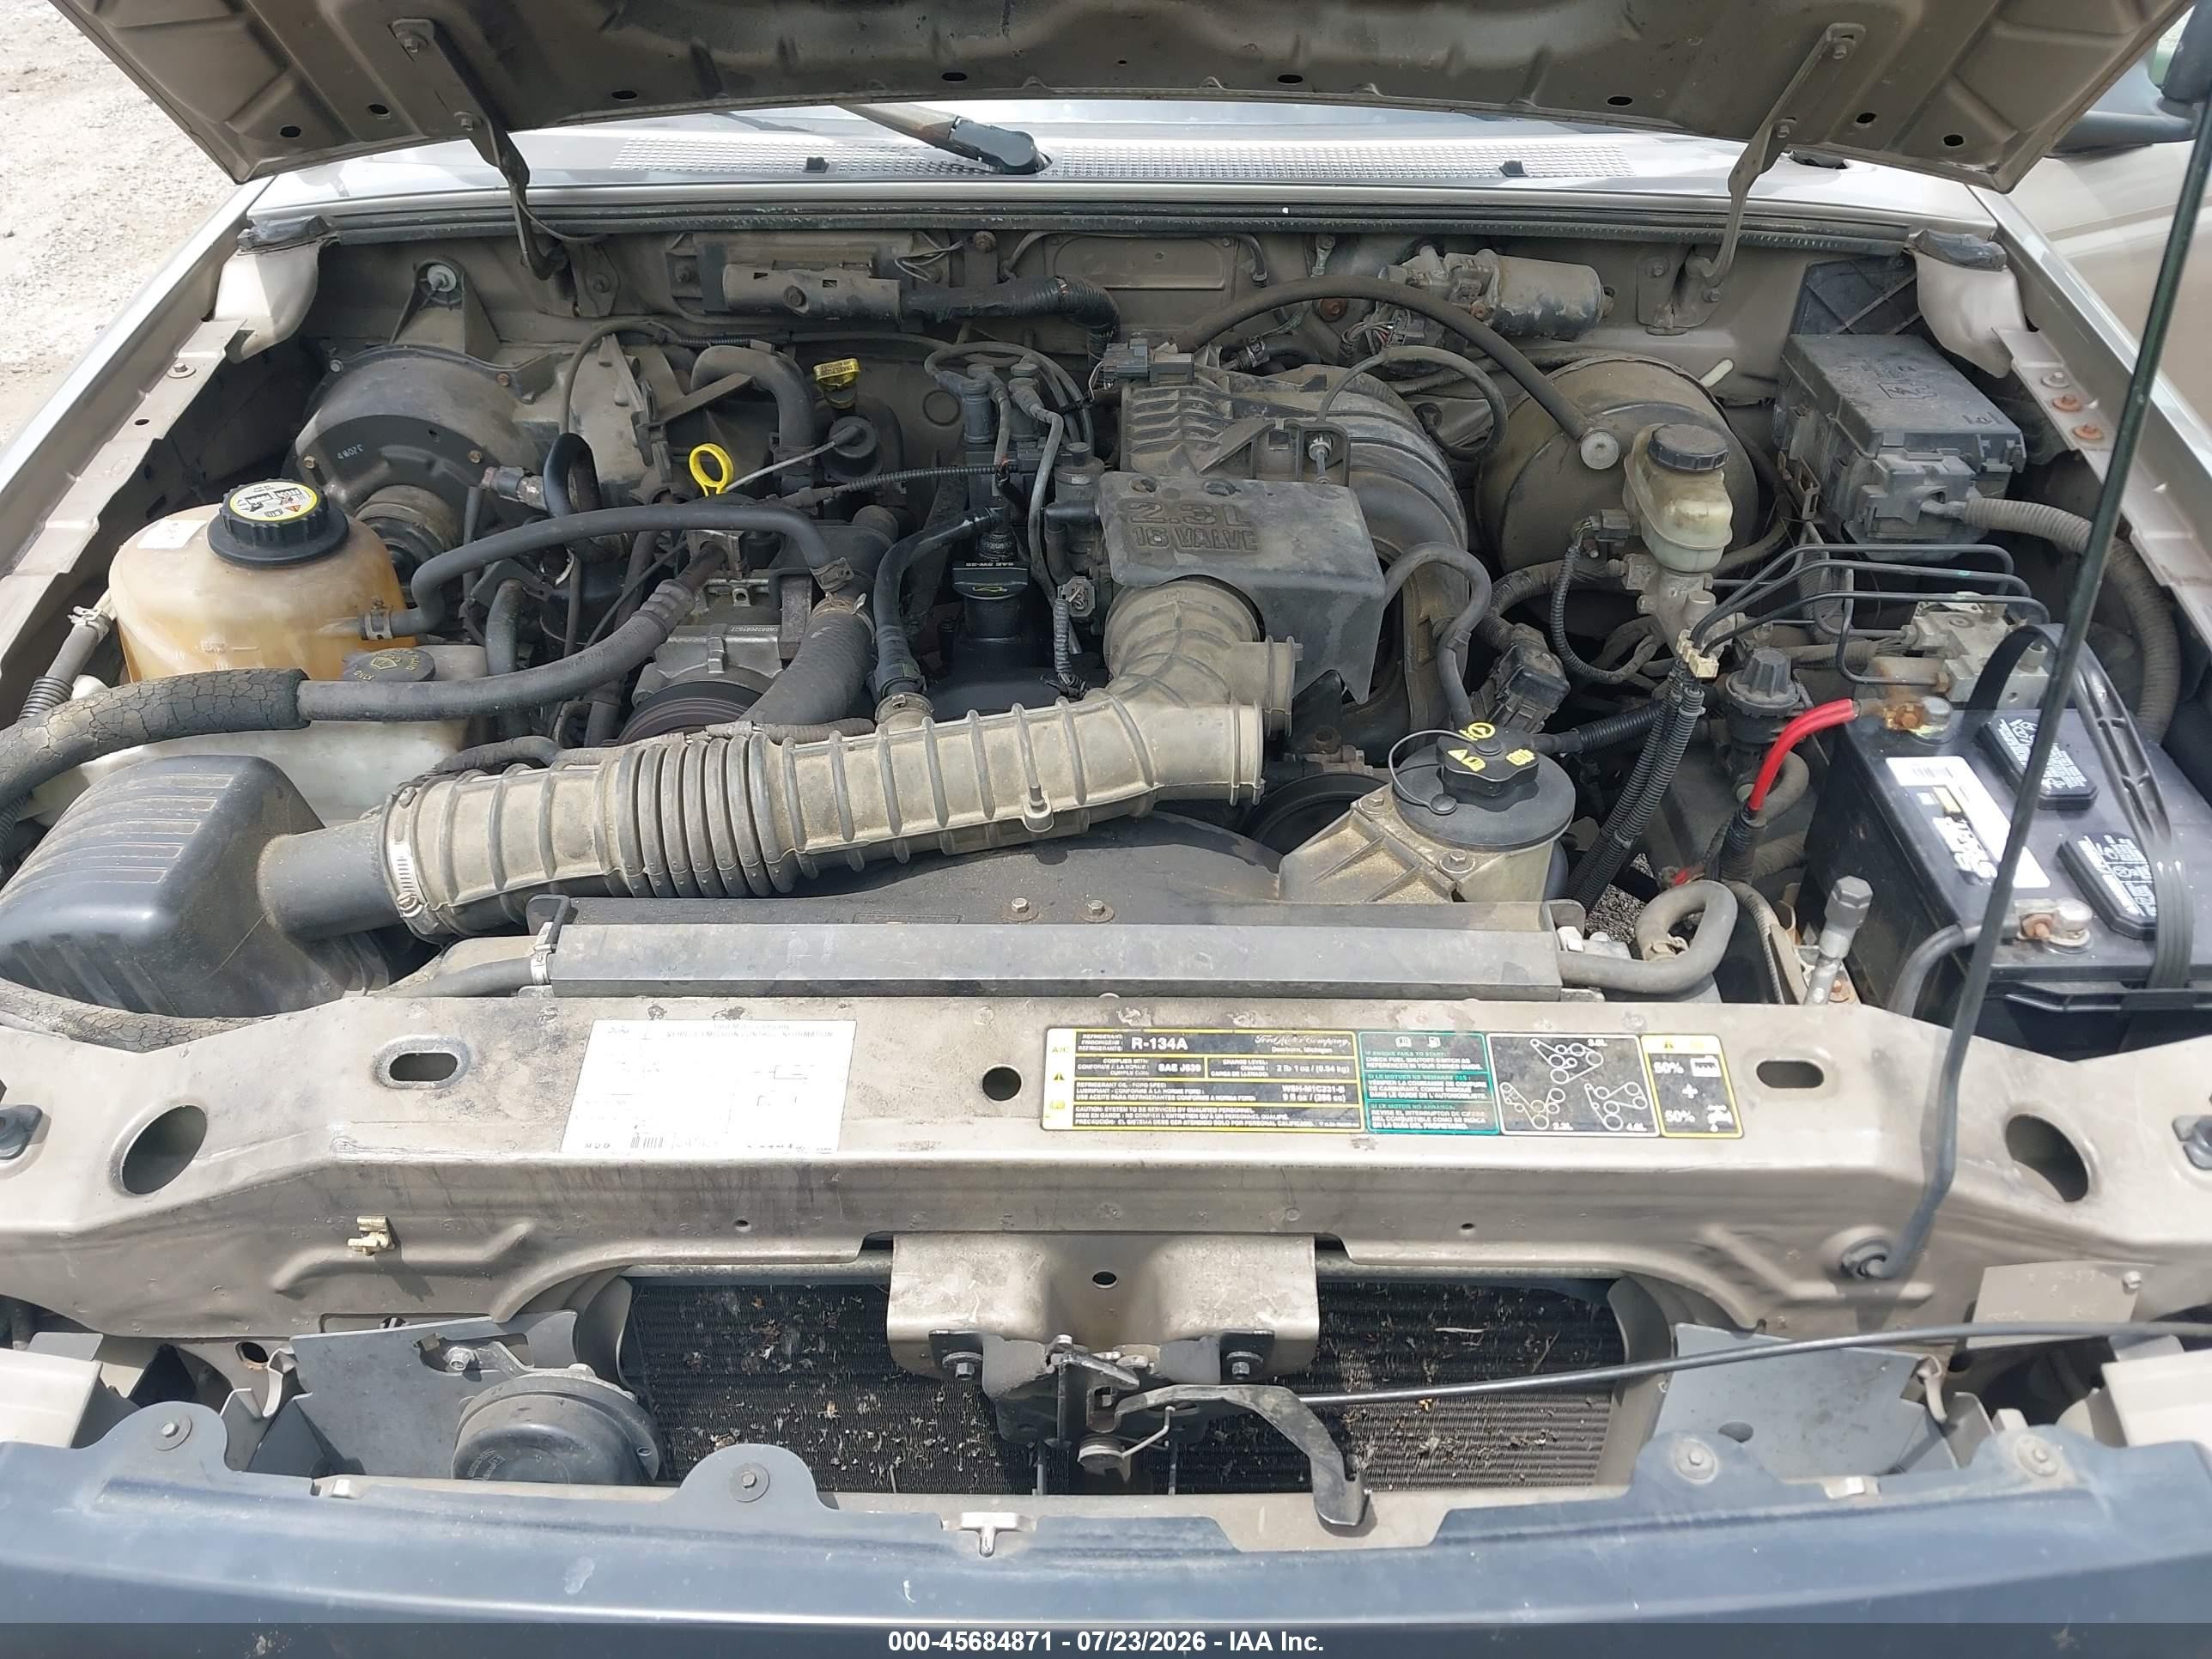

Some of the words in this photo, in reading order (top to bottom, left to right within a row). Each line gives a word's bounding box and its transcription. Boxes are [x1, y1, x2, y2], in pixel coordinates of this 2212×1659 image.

[1174, 527, 1258, 550] VALVE
[1131, 1036, 1188, 1050] R-134A
[1255, 1034, 1278, 1047] Ford
[1158, 1063, 1178, 1072] SAE
[1276, 1064, 1282, 1073] 2
[1284, 1064, 1292, 1073] lb
[1300, 1064, 1310, 1073] oz
[1653, 1061, 1685, 1074] 50%
[1665, 1110, 1696, 1123] 50%
